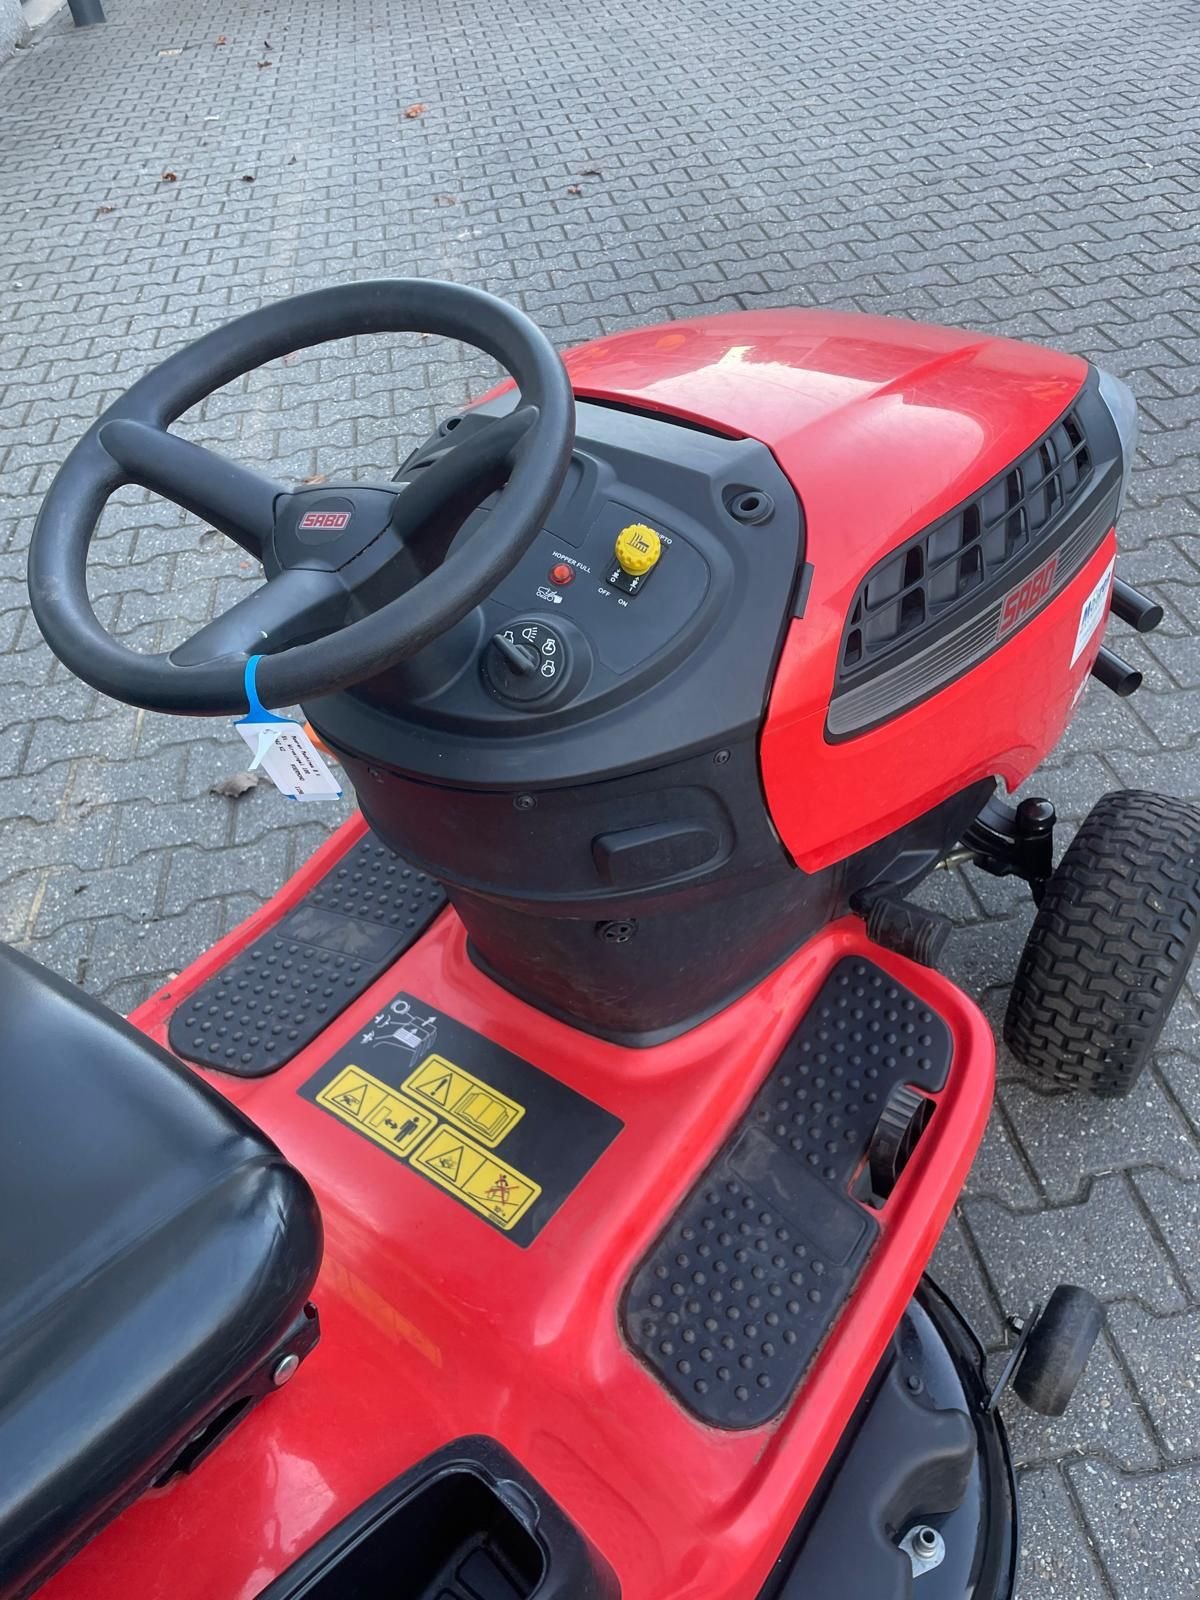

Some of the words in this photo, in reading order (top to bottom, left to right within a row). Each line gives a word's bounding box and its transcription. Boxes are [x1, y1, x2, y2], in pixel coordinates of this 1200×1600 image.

[303, 514, 348, 528] SABO
[552, 551, 577, 566] HOPPER
[576, 562, 591, 574] FULL
[597, 587, 611, 597] OFF
[1000, 558, 1057, 632] SABO
[618, 598, 628, 607] ON
